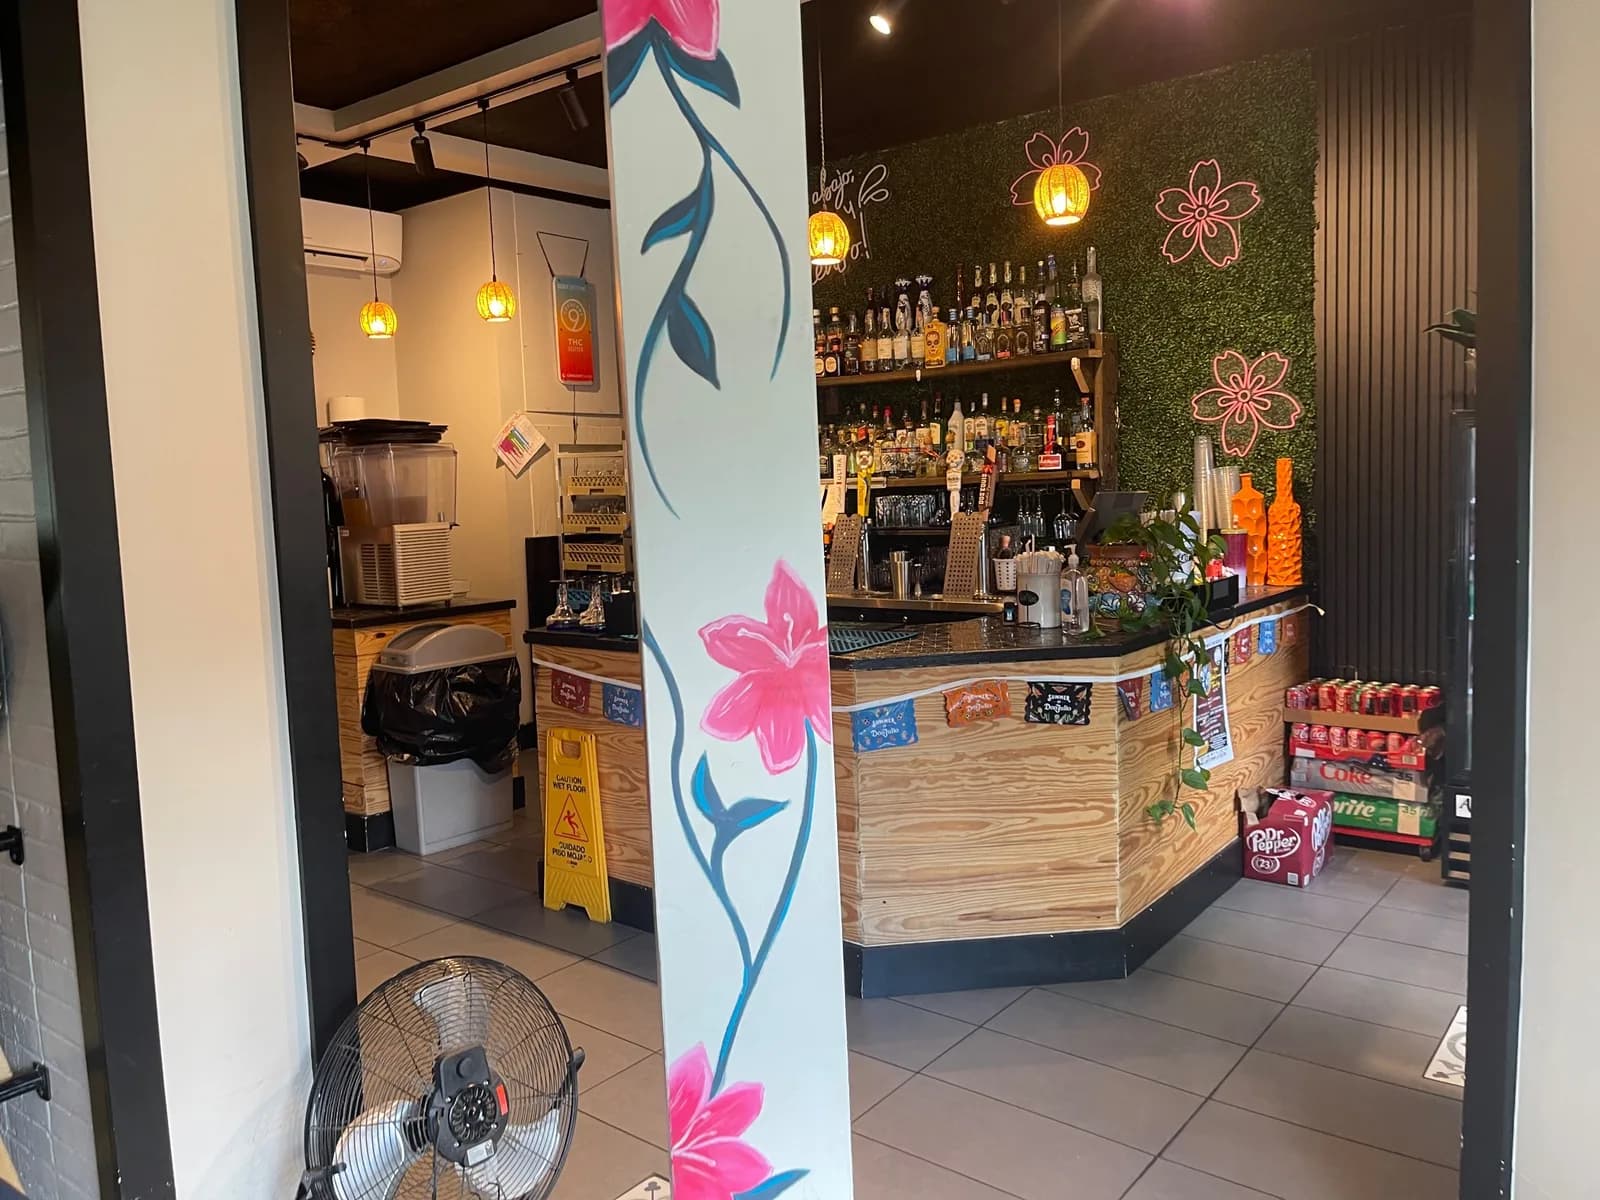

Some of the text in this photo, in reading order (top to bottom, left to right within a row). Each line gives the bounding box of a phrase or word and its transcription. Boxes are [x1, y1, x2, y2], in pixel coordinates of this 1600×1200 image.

[567, 338, 584, 347] THC
[556, 774, 583, 786] CAUTION
[1319, 761, 1373, 786] Coke
[552, 781, 587, 794] WET FLOOR
[1265, 827, 1285, 841] Dr
[1249, 829, 1298, 855] Pepper
[552, 847, 566, 858] PISO
